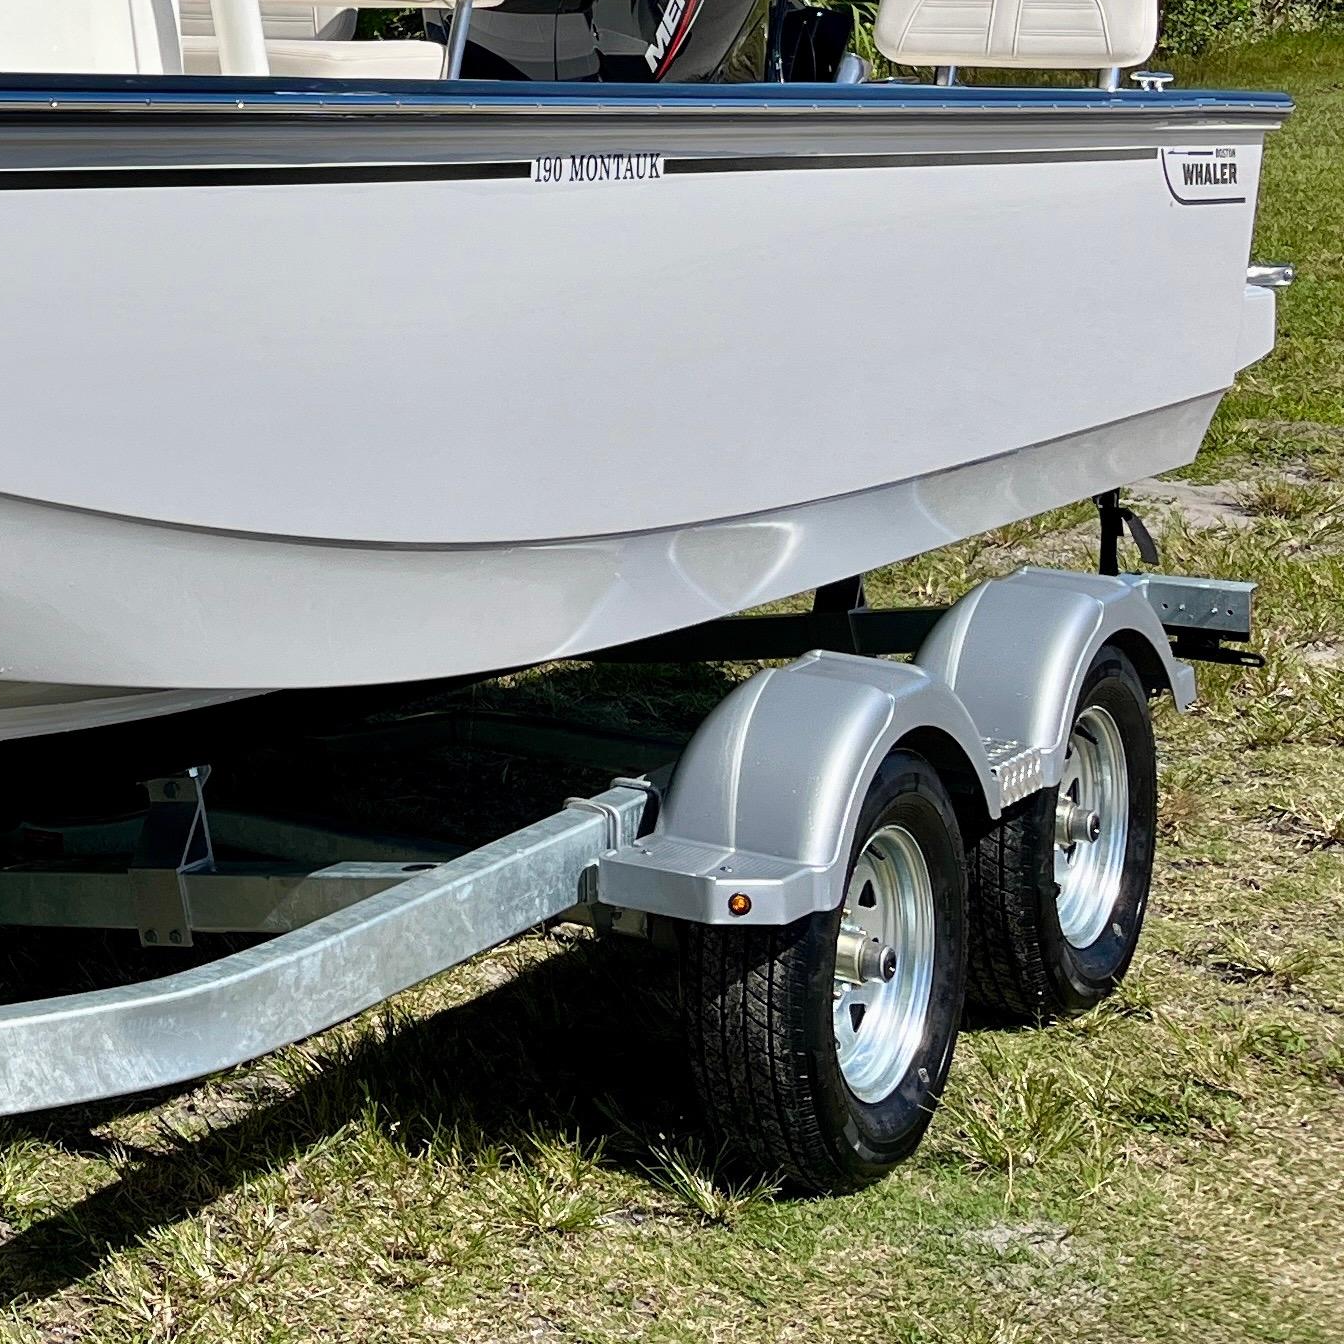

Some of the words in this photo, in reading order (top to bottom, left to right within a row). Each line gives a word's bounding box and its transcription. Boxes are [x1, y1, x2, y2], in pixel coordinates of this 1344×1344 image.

[535, 156, 563, 182] 190
[569, 153, 661, 182] MONTAUK
[1182, 163, 1238, 186] WHALER
